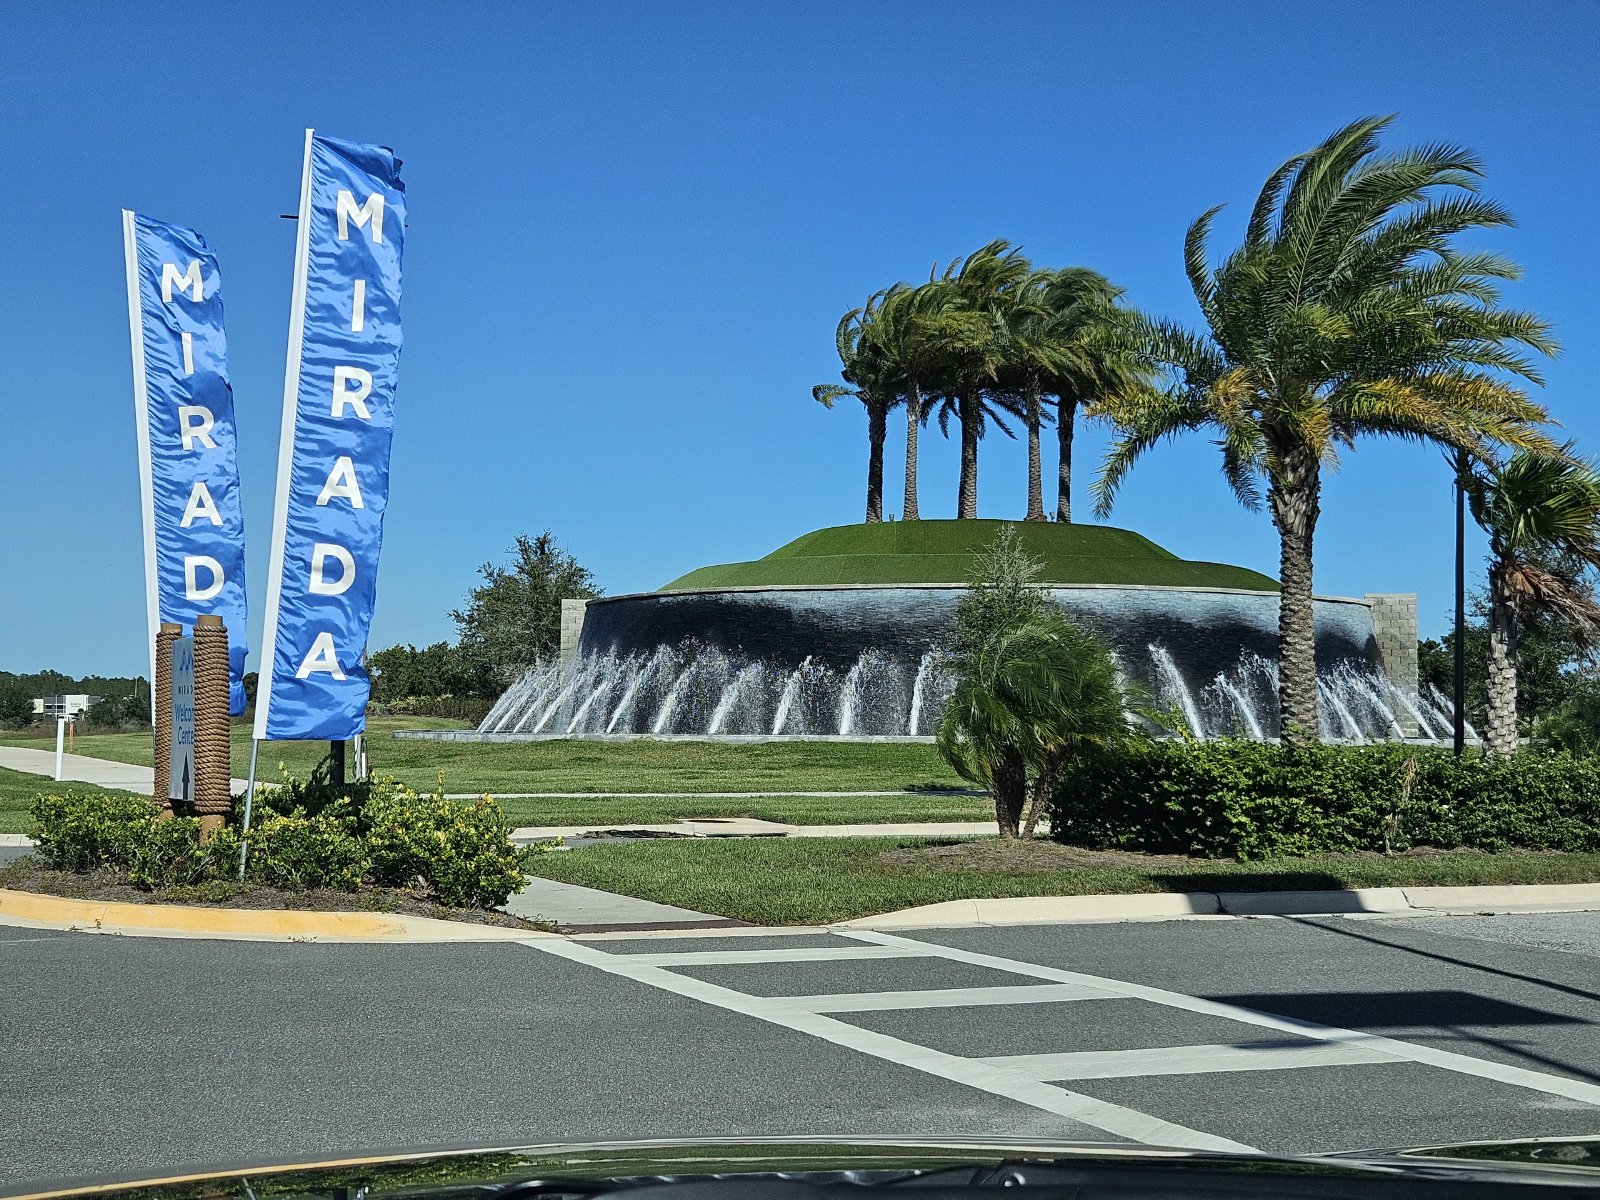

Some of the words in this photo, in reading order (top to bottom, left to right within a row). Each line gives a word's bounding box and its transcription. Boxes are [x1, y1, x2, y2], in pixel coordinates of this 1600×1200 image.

[161, 259, 225, 602] MIRAD
[295, 189, 385, 682] MIRADA
[178, 685, 194, 695] MIRAD
[175, 704, 194, 723] Welco
[178, 726, 194, 745] Cente
